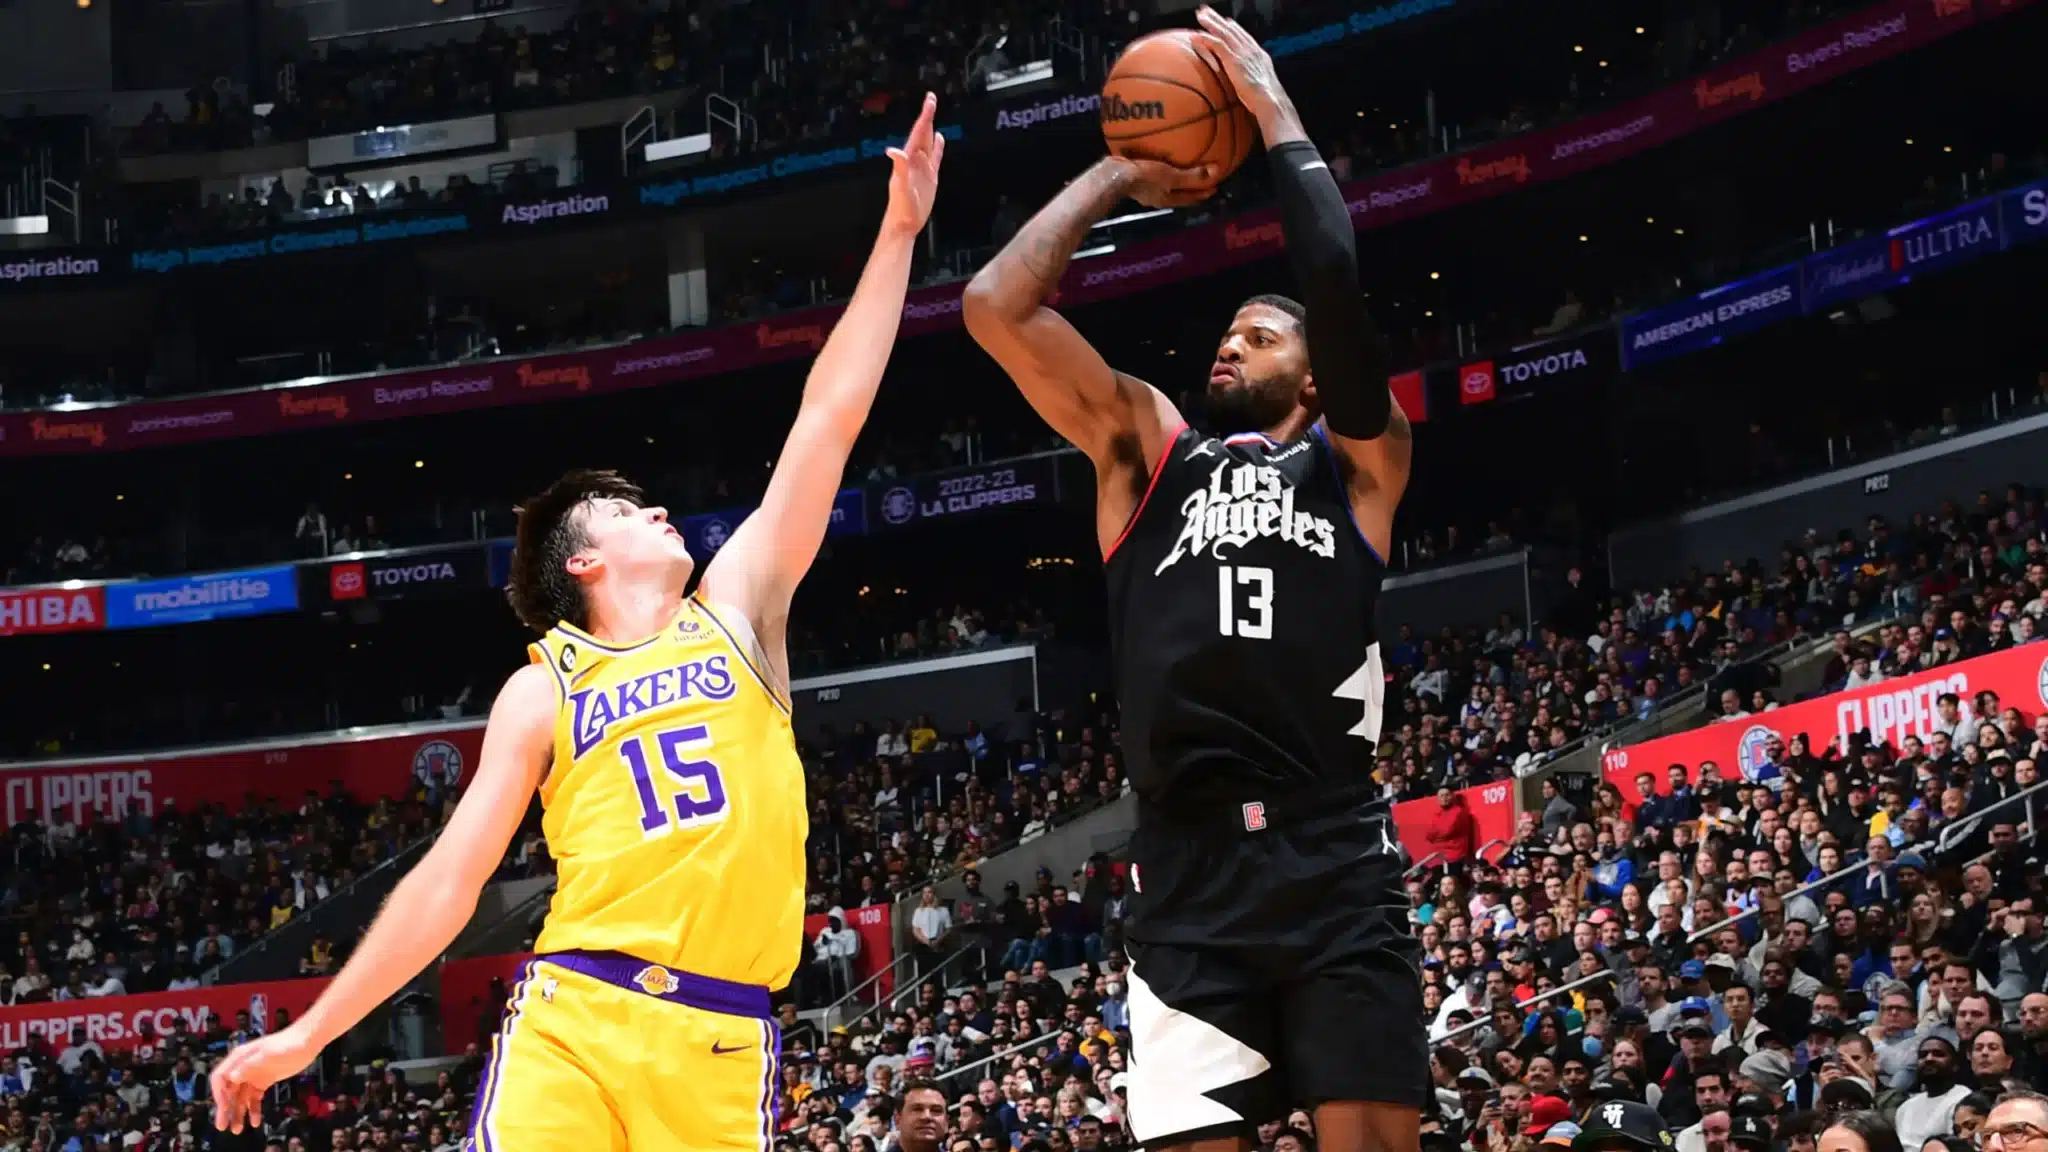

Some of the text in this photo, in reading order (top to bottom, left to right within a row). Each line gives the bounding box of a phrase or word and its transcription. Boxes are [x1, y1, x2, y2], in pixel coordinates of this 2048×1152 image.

[996, 94, 1101, 131] Aspiration
[502, 192, 608, 224] Aspiration
[1903, 214, 1993, 264] ULTRA
[1633, 283, 1793, 350] AMERICAN EXPRESS
[1501, 349, 1589, 386] TOYOTA
[921, 484, 1037, 518] LA CLIPPERS
[939, 468, 1017, 497] 2022-23
[1205, 458, 1283, 507] Los
[1155, 486, 1336, 577] Angeles
[372, 561, 456, 587] TOYOTA
[0, 594, 96, 628] HIBA
[134, 576, 270, 611] mobilitie
[1218, 565, 1275, 640] 13
[568, 654, 737, 762] LAKERS
[619, 722, 731, 838] 15
[1605, 751, 1628, 773] 110
[5, 769, 153, 828] CLIPPERS
[1482, 785, 1507, 805] 109
[859, 910, 882, 925] 108
[0, 1005, 210, 1050] LIPPERS.COM
